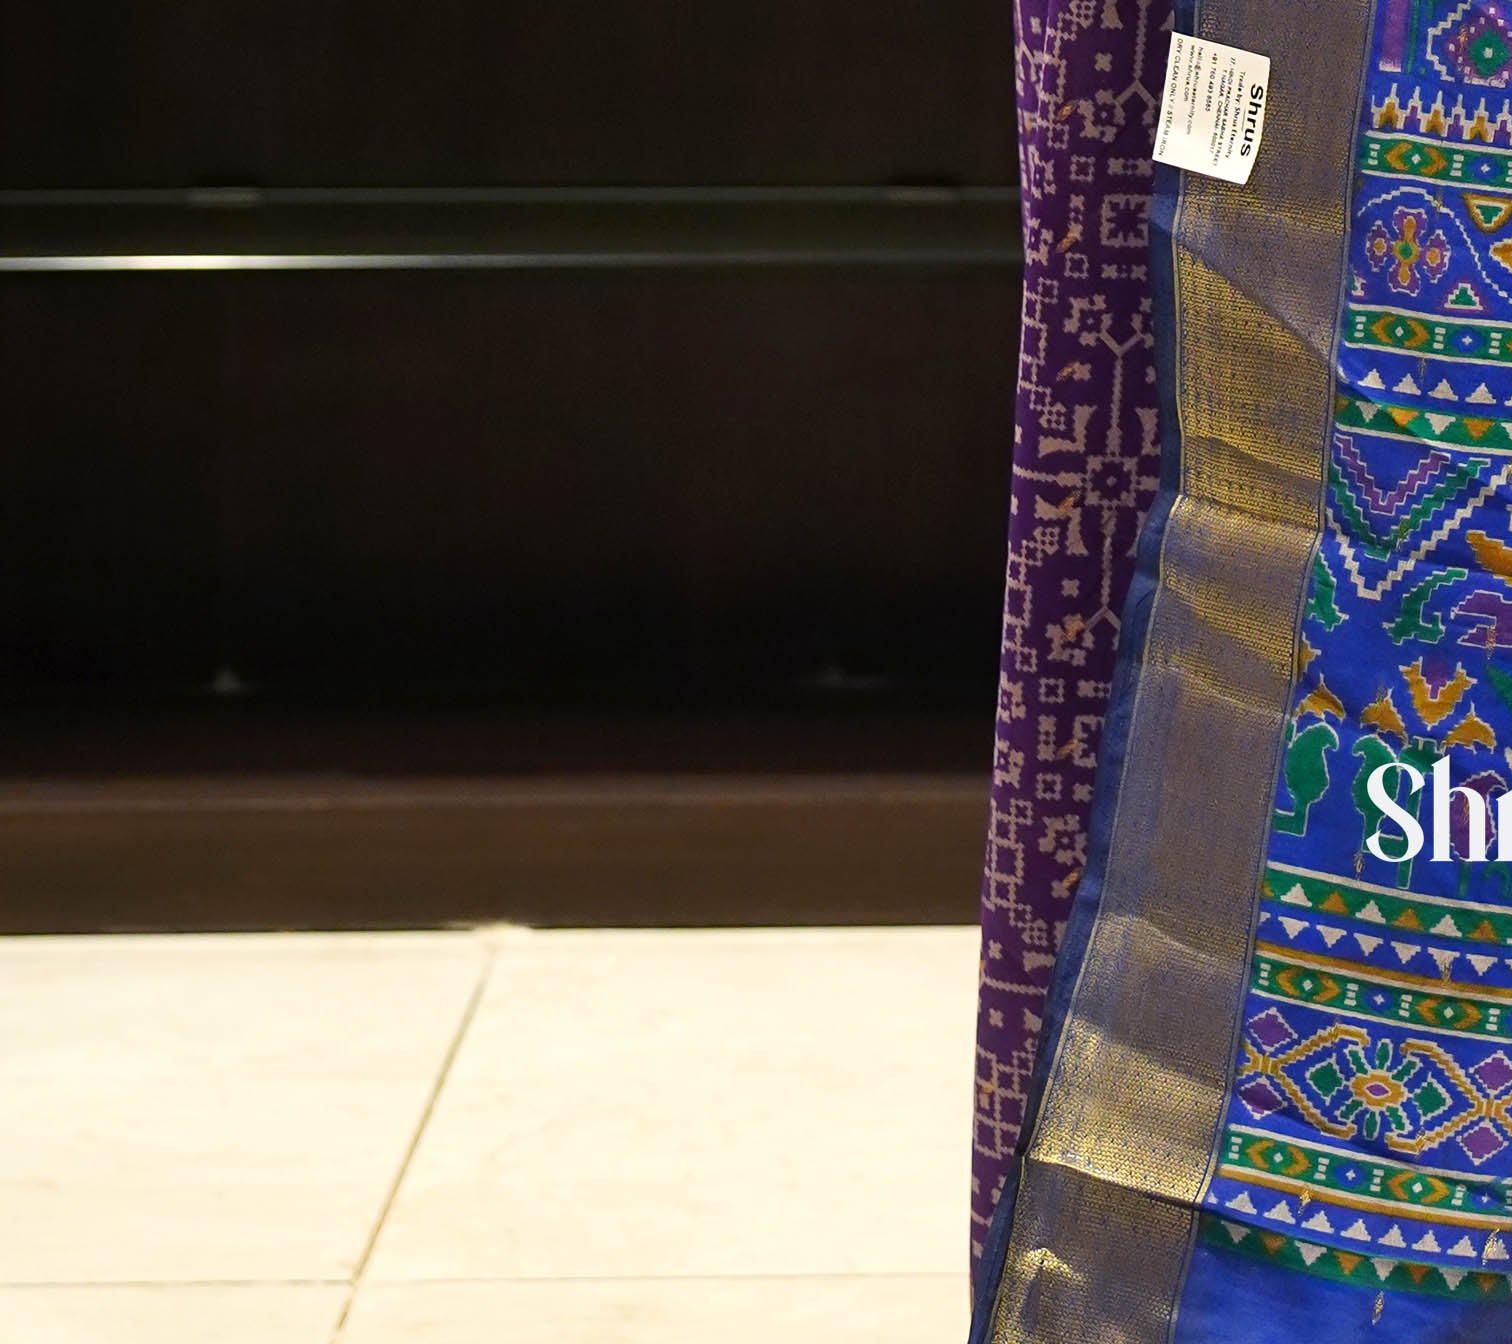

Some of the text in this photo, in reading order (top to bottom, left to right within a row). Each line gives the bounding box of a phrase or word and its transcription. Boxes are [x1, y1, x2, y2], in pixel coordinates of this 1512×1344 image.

[1172, 56, 1181, 82] CLEAN
[1164, 110, 1173, 136] STEAM
[1232, 107, 1240, 127] Shrus
[1240, 84, 1264, 156] Shrus
[1158, 137, 1168, 156] IRON
